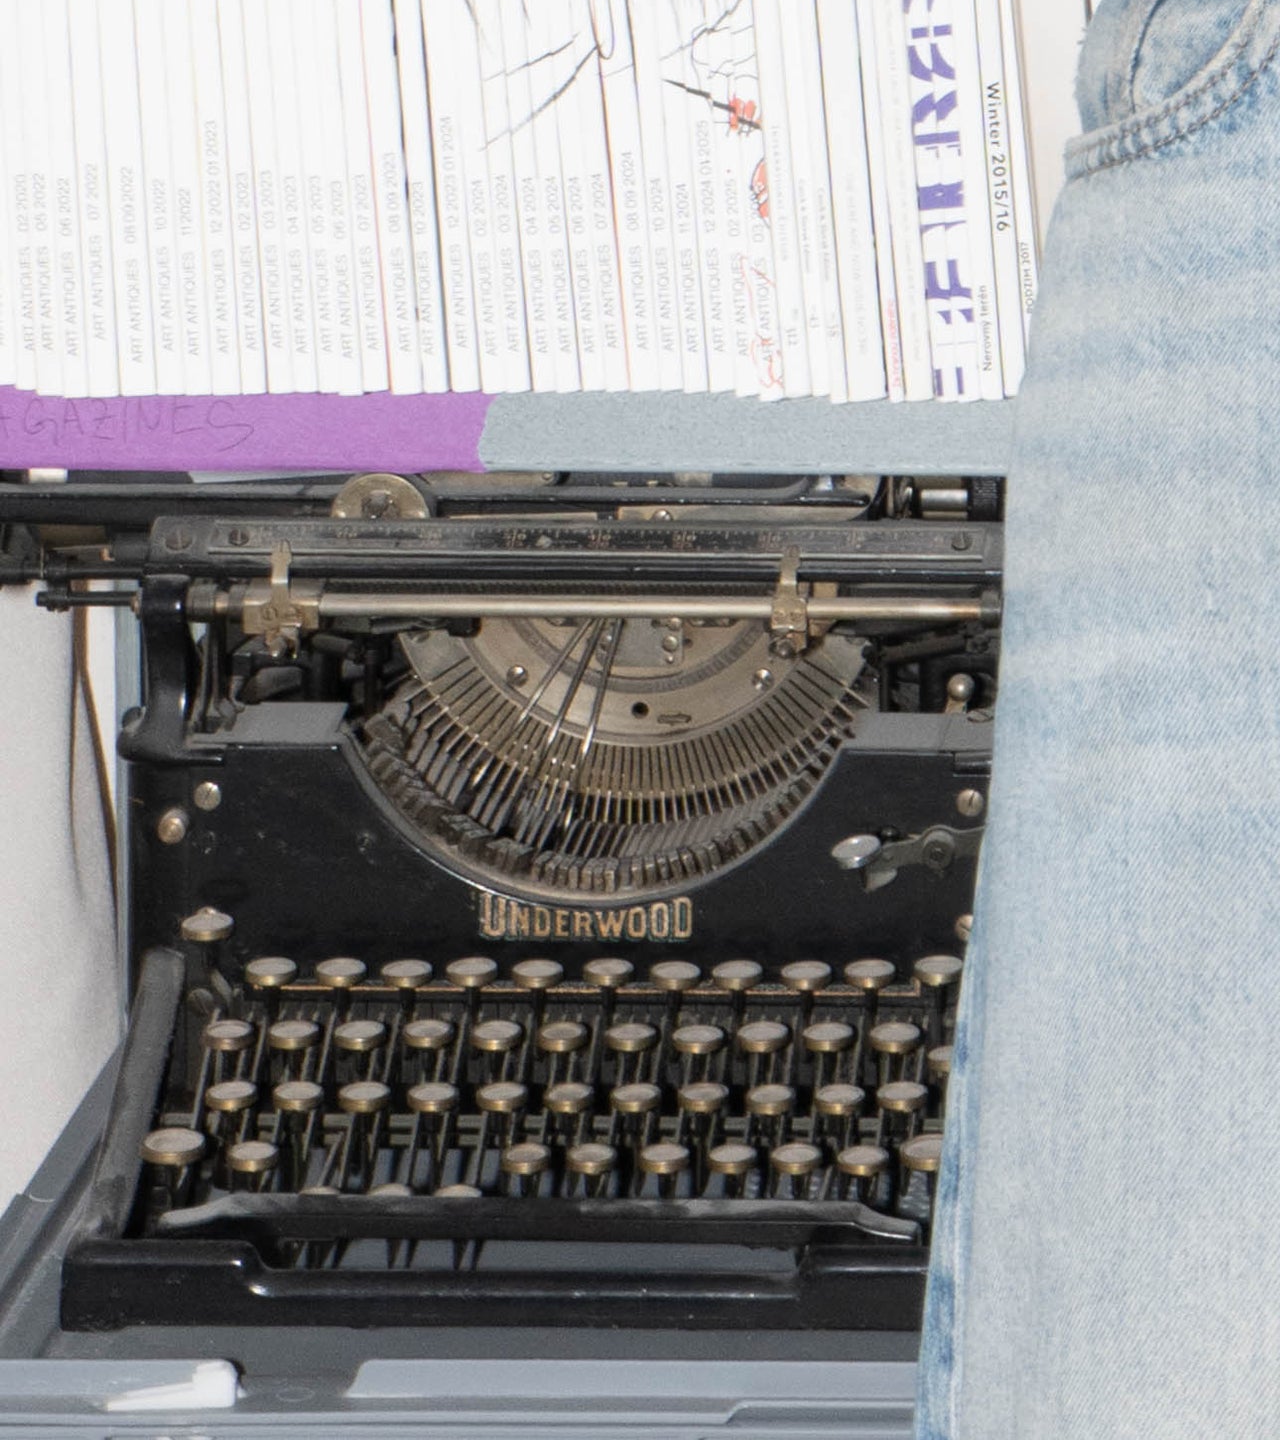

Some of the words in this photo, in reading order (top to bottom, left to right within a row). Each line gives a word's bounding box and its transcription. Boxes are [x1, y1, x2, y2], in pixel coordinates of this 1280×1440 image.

[984, 79, 1001, 150] Winter
[989, 151, 1010, 235] 2015/16
[479, 891, 694, 940] UNDERWOOD
